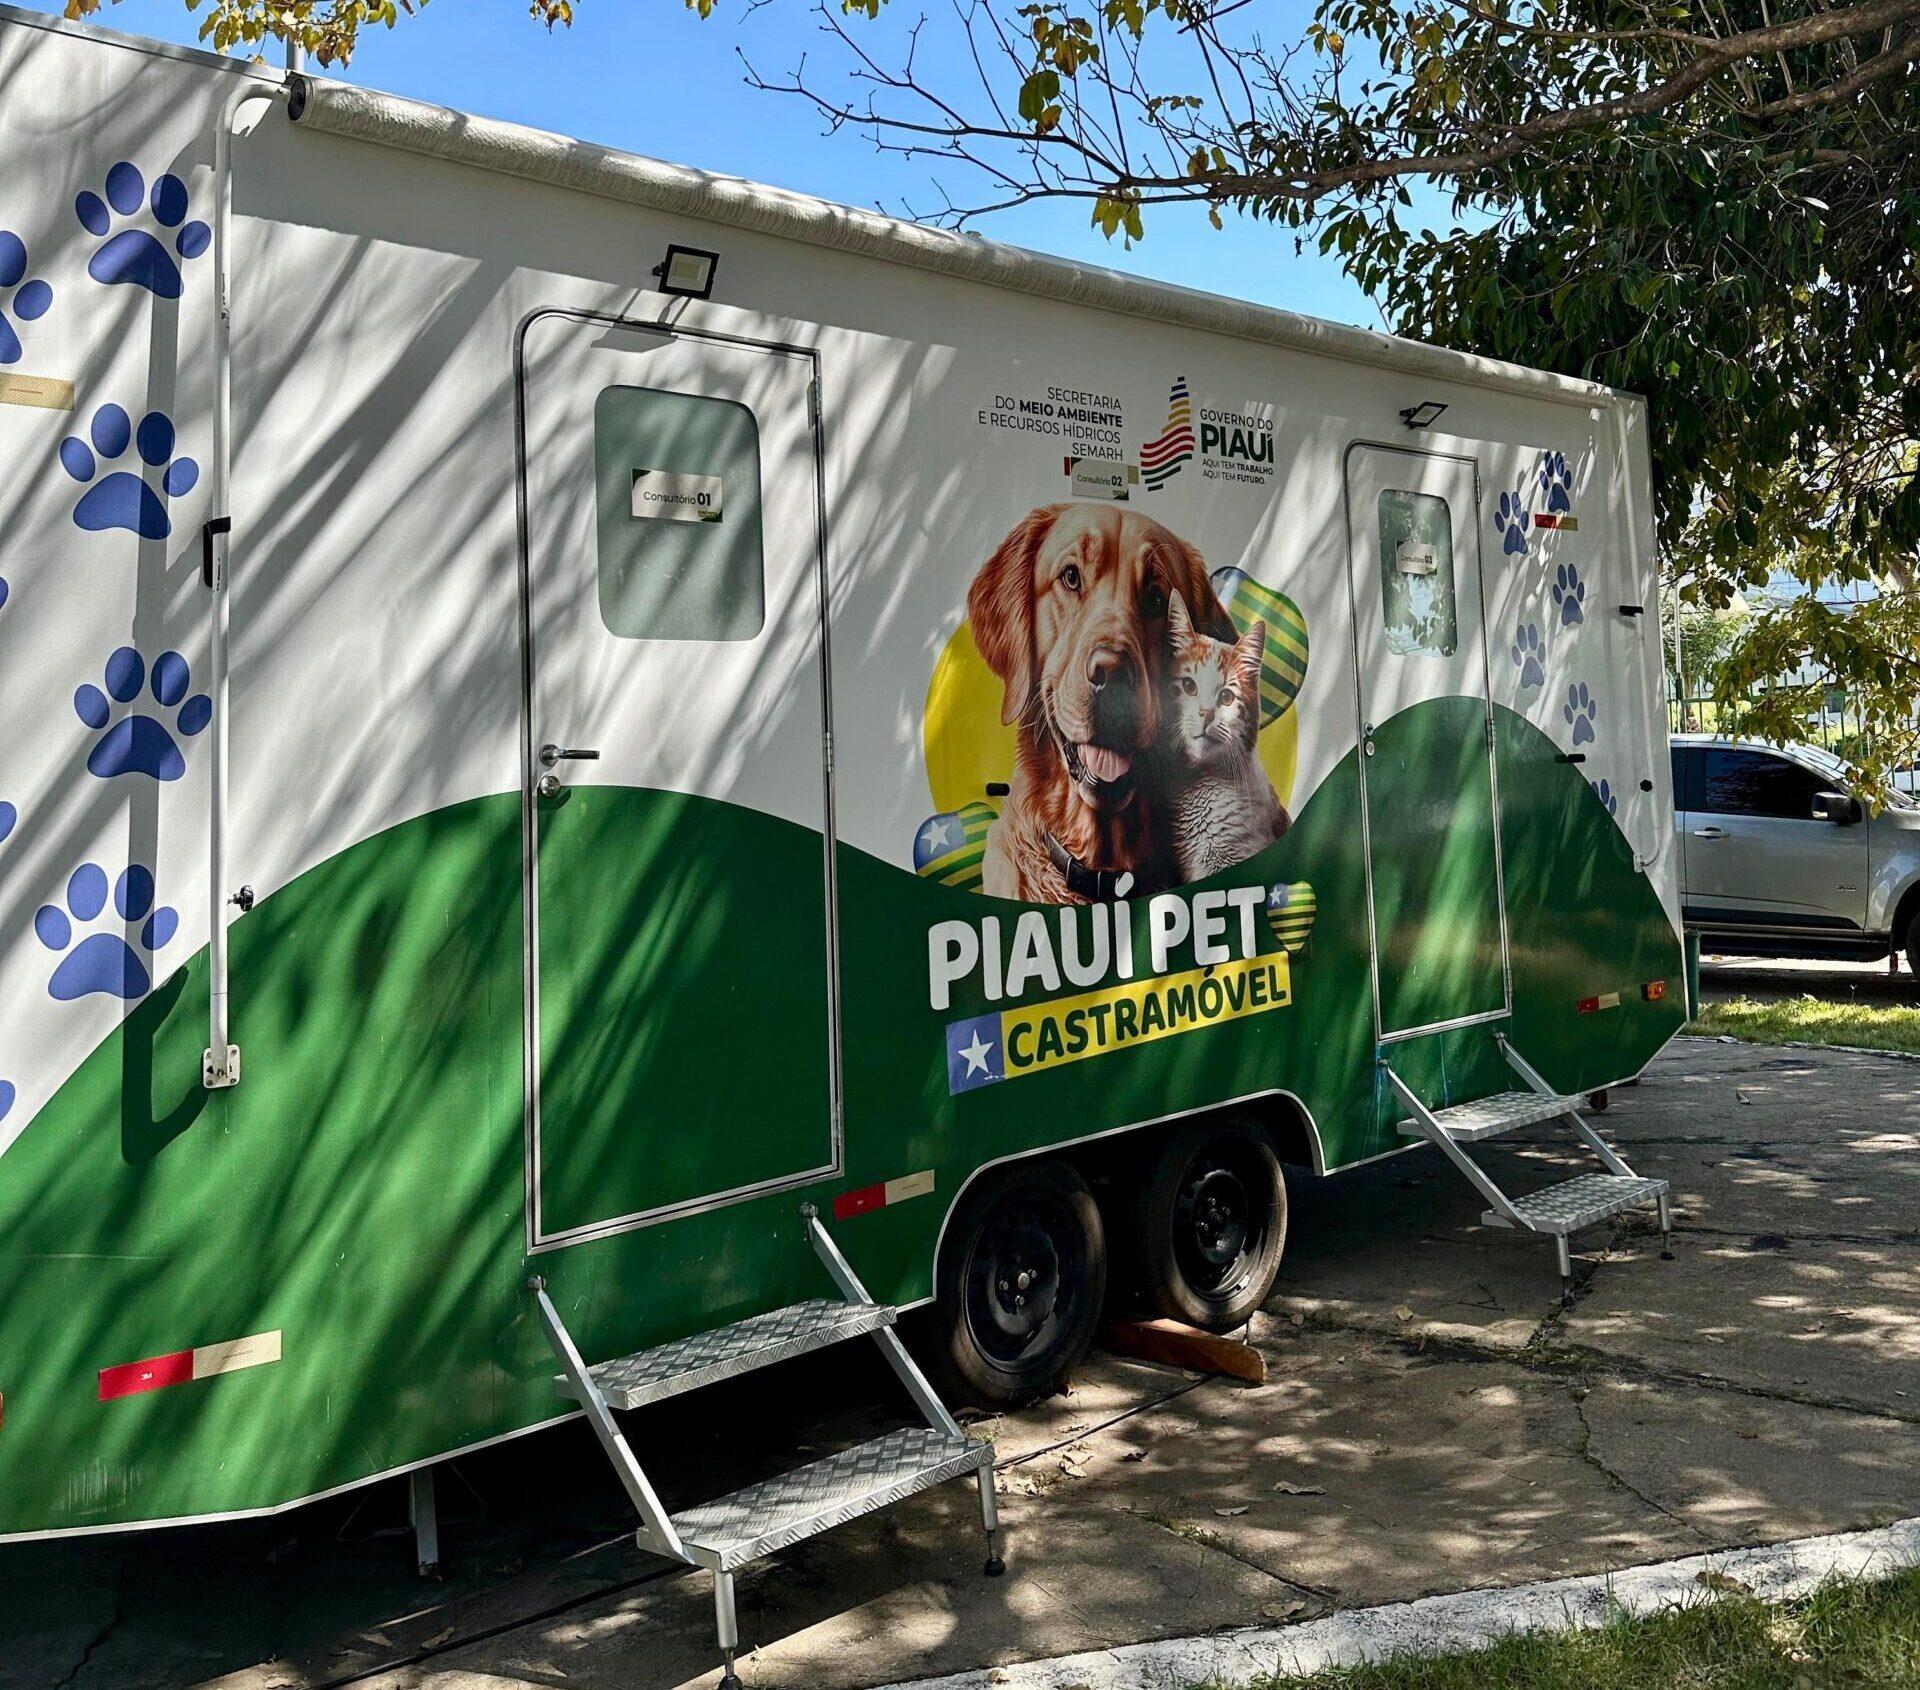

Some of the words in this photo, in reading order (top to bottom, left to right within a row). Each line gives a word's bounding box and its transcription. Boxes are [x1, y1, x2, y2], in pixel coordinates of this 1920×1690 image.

[1047, 387, 1122, 411] SECRETARIA
[995, 395, 1016, 411] DO
[1020, 400, 1054, 417] MEIO
[1057, 406, 1123, 428] AMBIENTE
[1200, 408, 1255, 429] GOVERNO
[1258, 418, 1274, 431] DO
[978, 410, 987, 425] E
[990, 412, 1060, 436] RECURSOS
[1063, 422, 1121, 444] HÍDRICOS
[1072, 442, 1123, 461] SEMARH
[1200, 422, 1274, 464] PIAUÍ
[1202, 458, 1220, 469] AQUI
[1221, 460, 1235, 470] TEM
[1236, 463, 1274, 475] TRABALHO
[1203, 469, 1221, 480] AQUI
[1222, 472, 1236, 481] TEM
[1111, 475, 1123, 487] 02
[643, 491, 696, 505] Consultório
[697, 492, 711, 507] 01
[1424, 555, 1432, 565] 03
[928, 872, 1134, 1011] PIAUÍ
[1149, 885, 1266, 973] PET
[1007, 963, 1287, 1068] CASTRAMÓVEL
[141, 1372, 153, 1380] 3M
